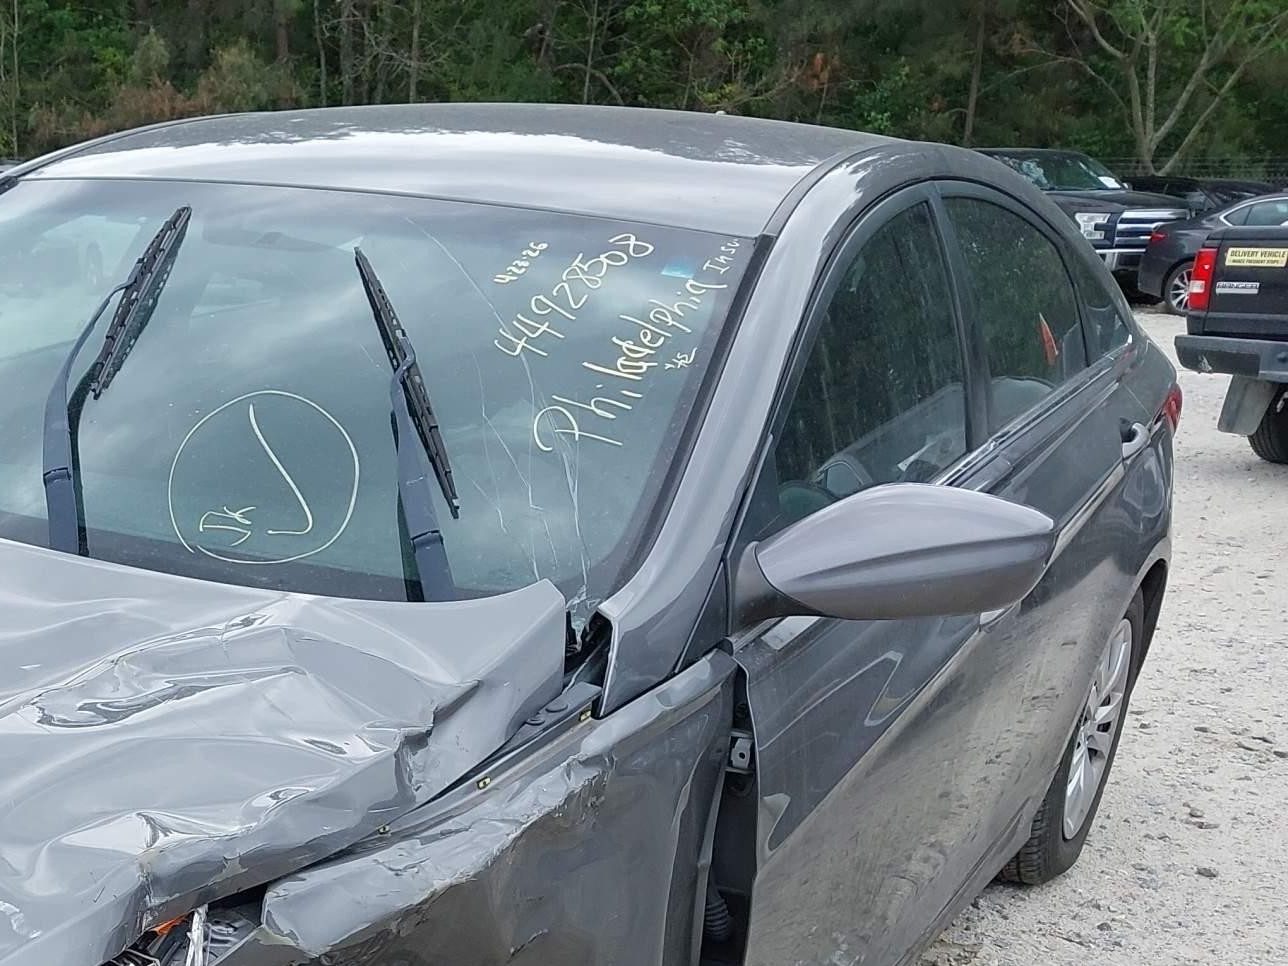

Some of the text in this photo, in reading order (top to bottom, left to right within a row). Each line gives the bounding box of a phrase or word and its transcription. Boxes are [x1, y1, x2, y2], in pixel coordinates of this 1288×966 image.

[494, 233, 655, 357] 44928508
[1230, 250, 1286, 258] DELIVERY VEHICLE
[533, 279, 728, 451] Philadelphia
